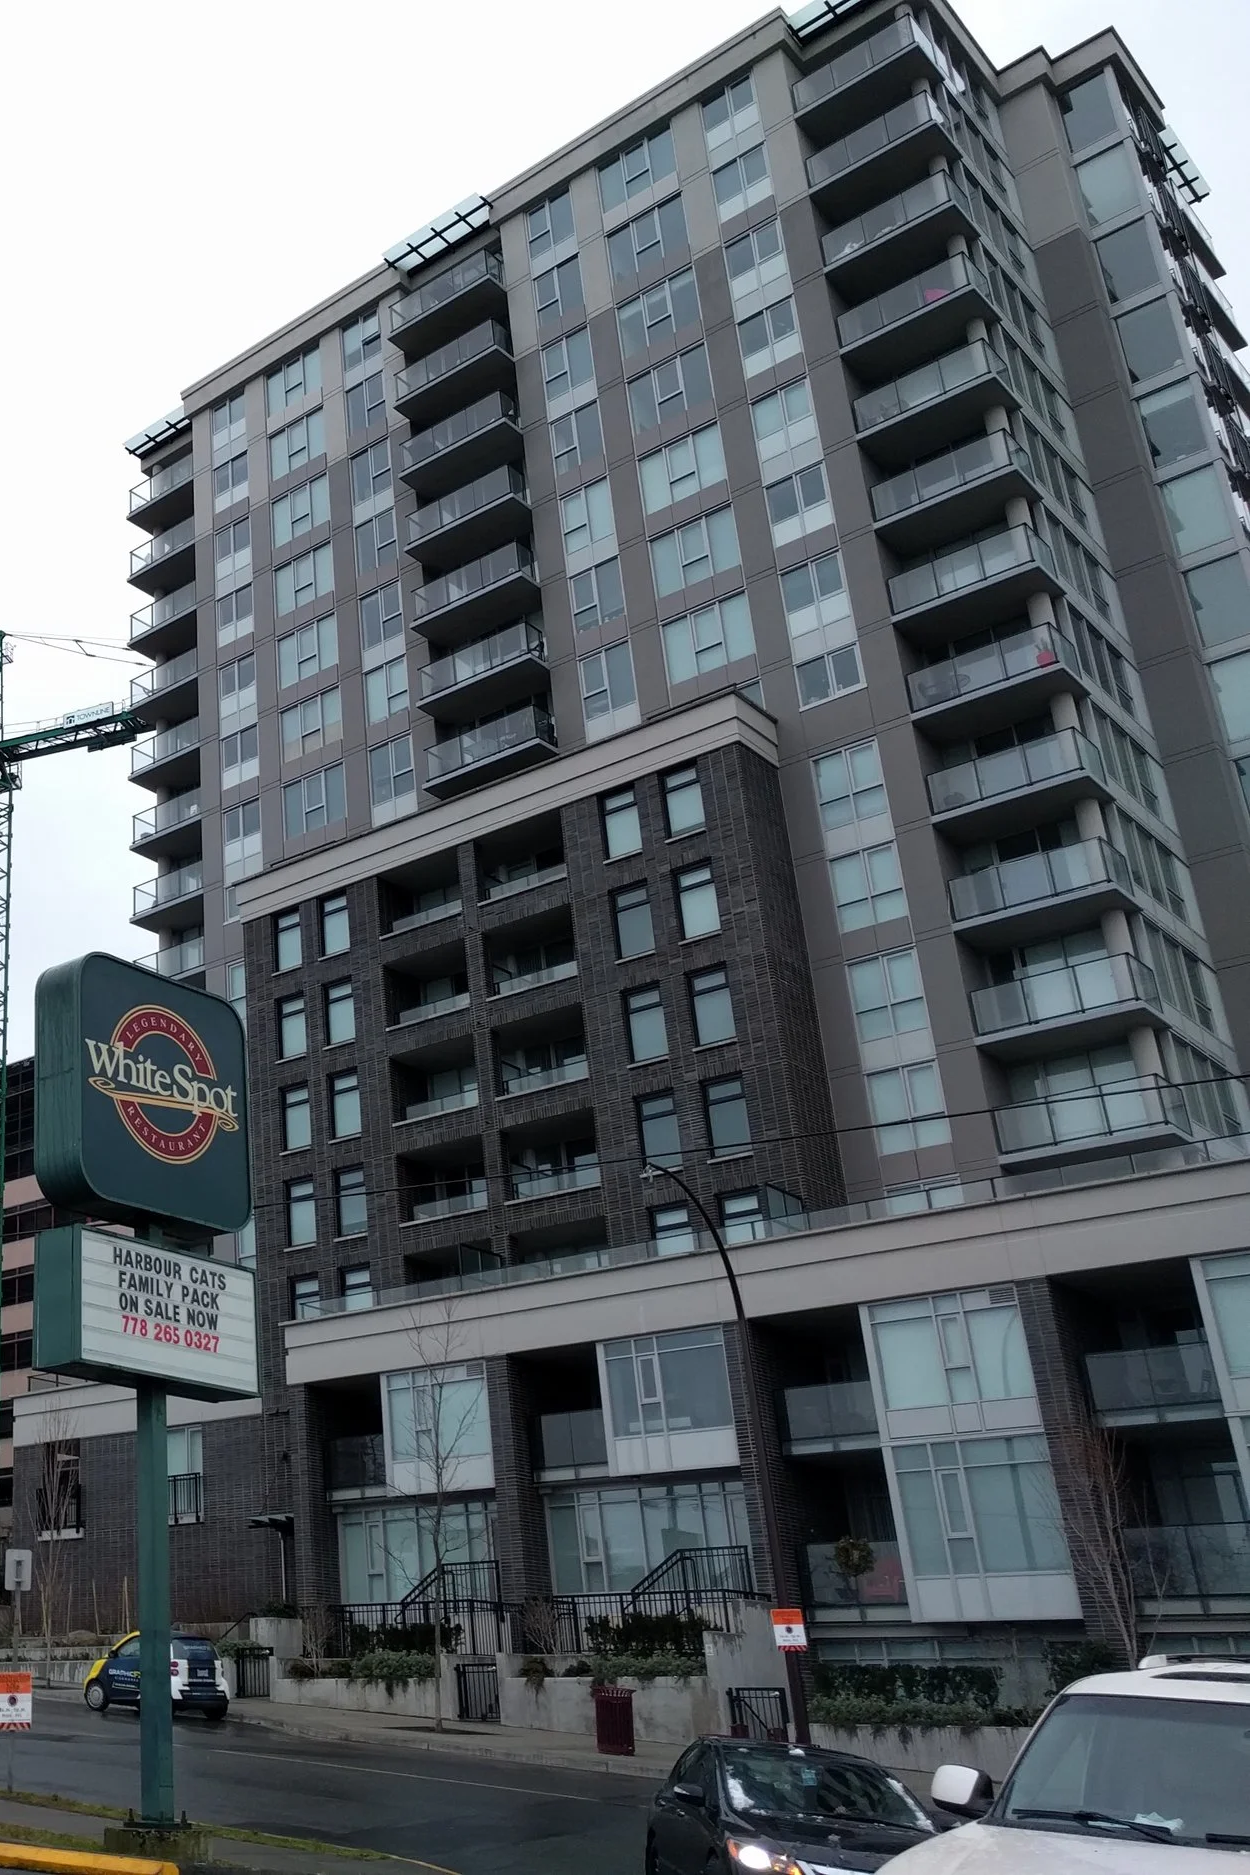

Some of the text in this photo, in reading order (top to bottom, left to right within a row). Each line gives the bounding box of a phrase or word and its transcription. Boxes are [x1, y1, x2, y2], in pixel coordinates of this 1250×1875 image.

[76, 707, 110, 720] TOWNLINE
[125, 1017, 203, 1061] LEGENDARY
[127, 1105, 206, 1151] RESTAURANT
[113, 1246, 226, 1290] HARBOUR CATS
[118, 1270, 220, 1311] FAMILY PACK
[119, 1292, 219, 1330] ON SALE NOW
[122, 1315, 220, 1353] 778 265 0327
